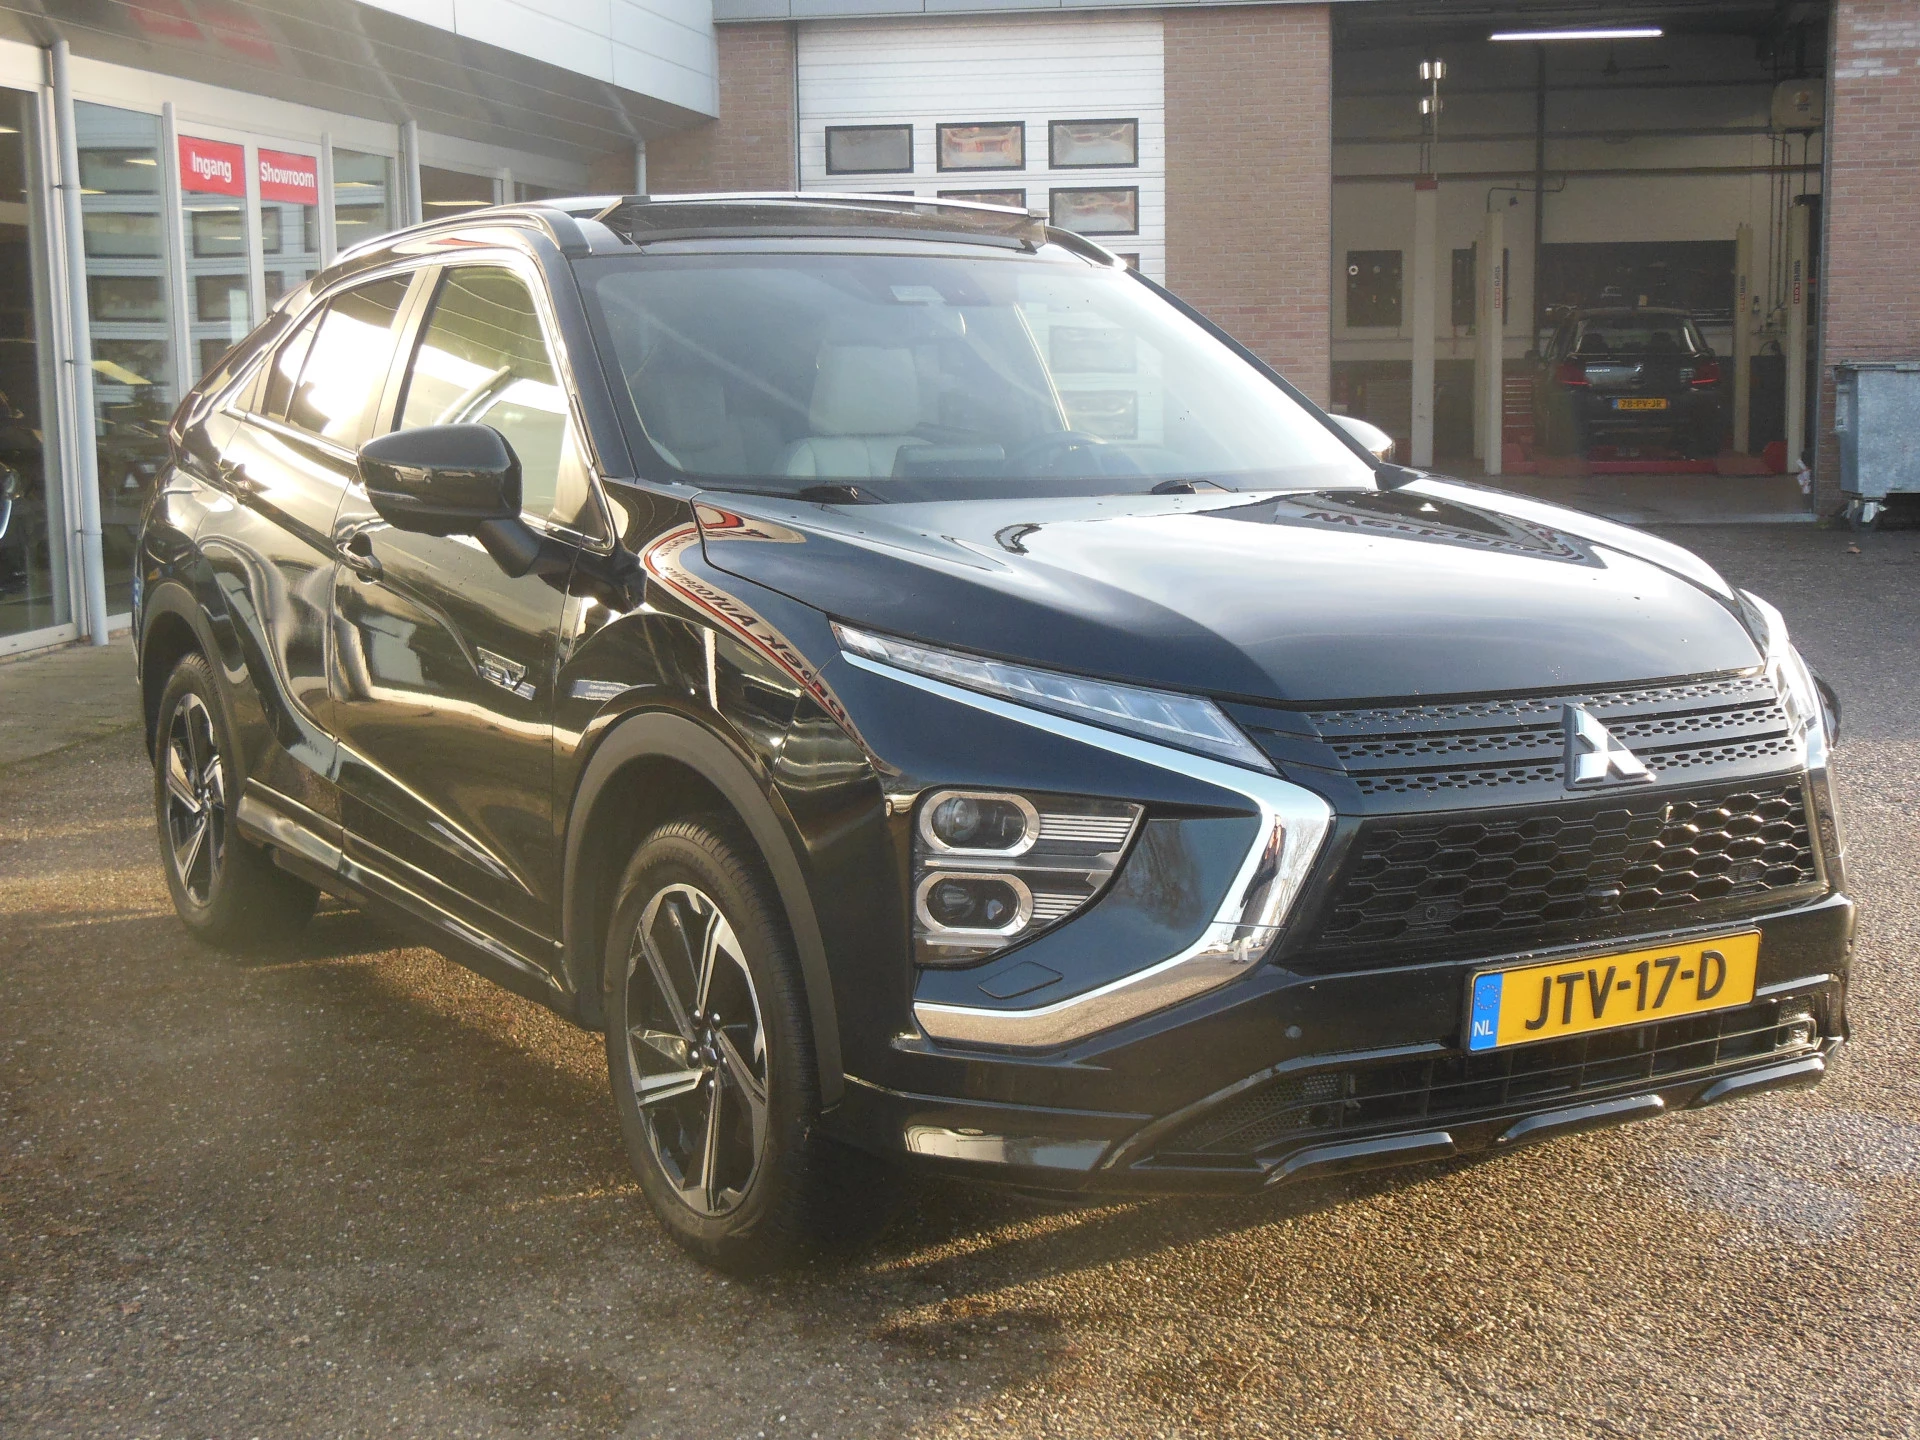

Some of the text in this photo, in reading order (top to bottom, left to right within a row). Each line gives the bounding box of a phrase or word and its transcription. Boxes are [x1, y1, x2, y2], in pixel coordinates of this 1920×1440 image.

[192, 151, 233, 183] Ingang
[260, 161, 315, 188] Showroom
[1525, 950, 1727, 1031] JTV-17-D
[1474, 1019, 1494, 1037] NL
